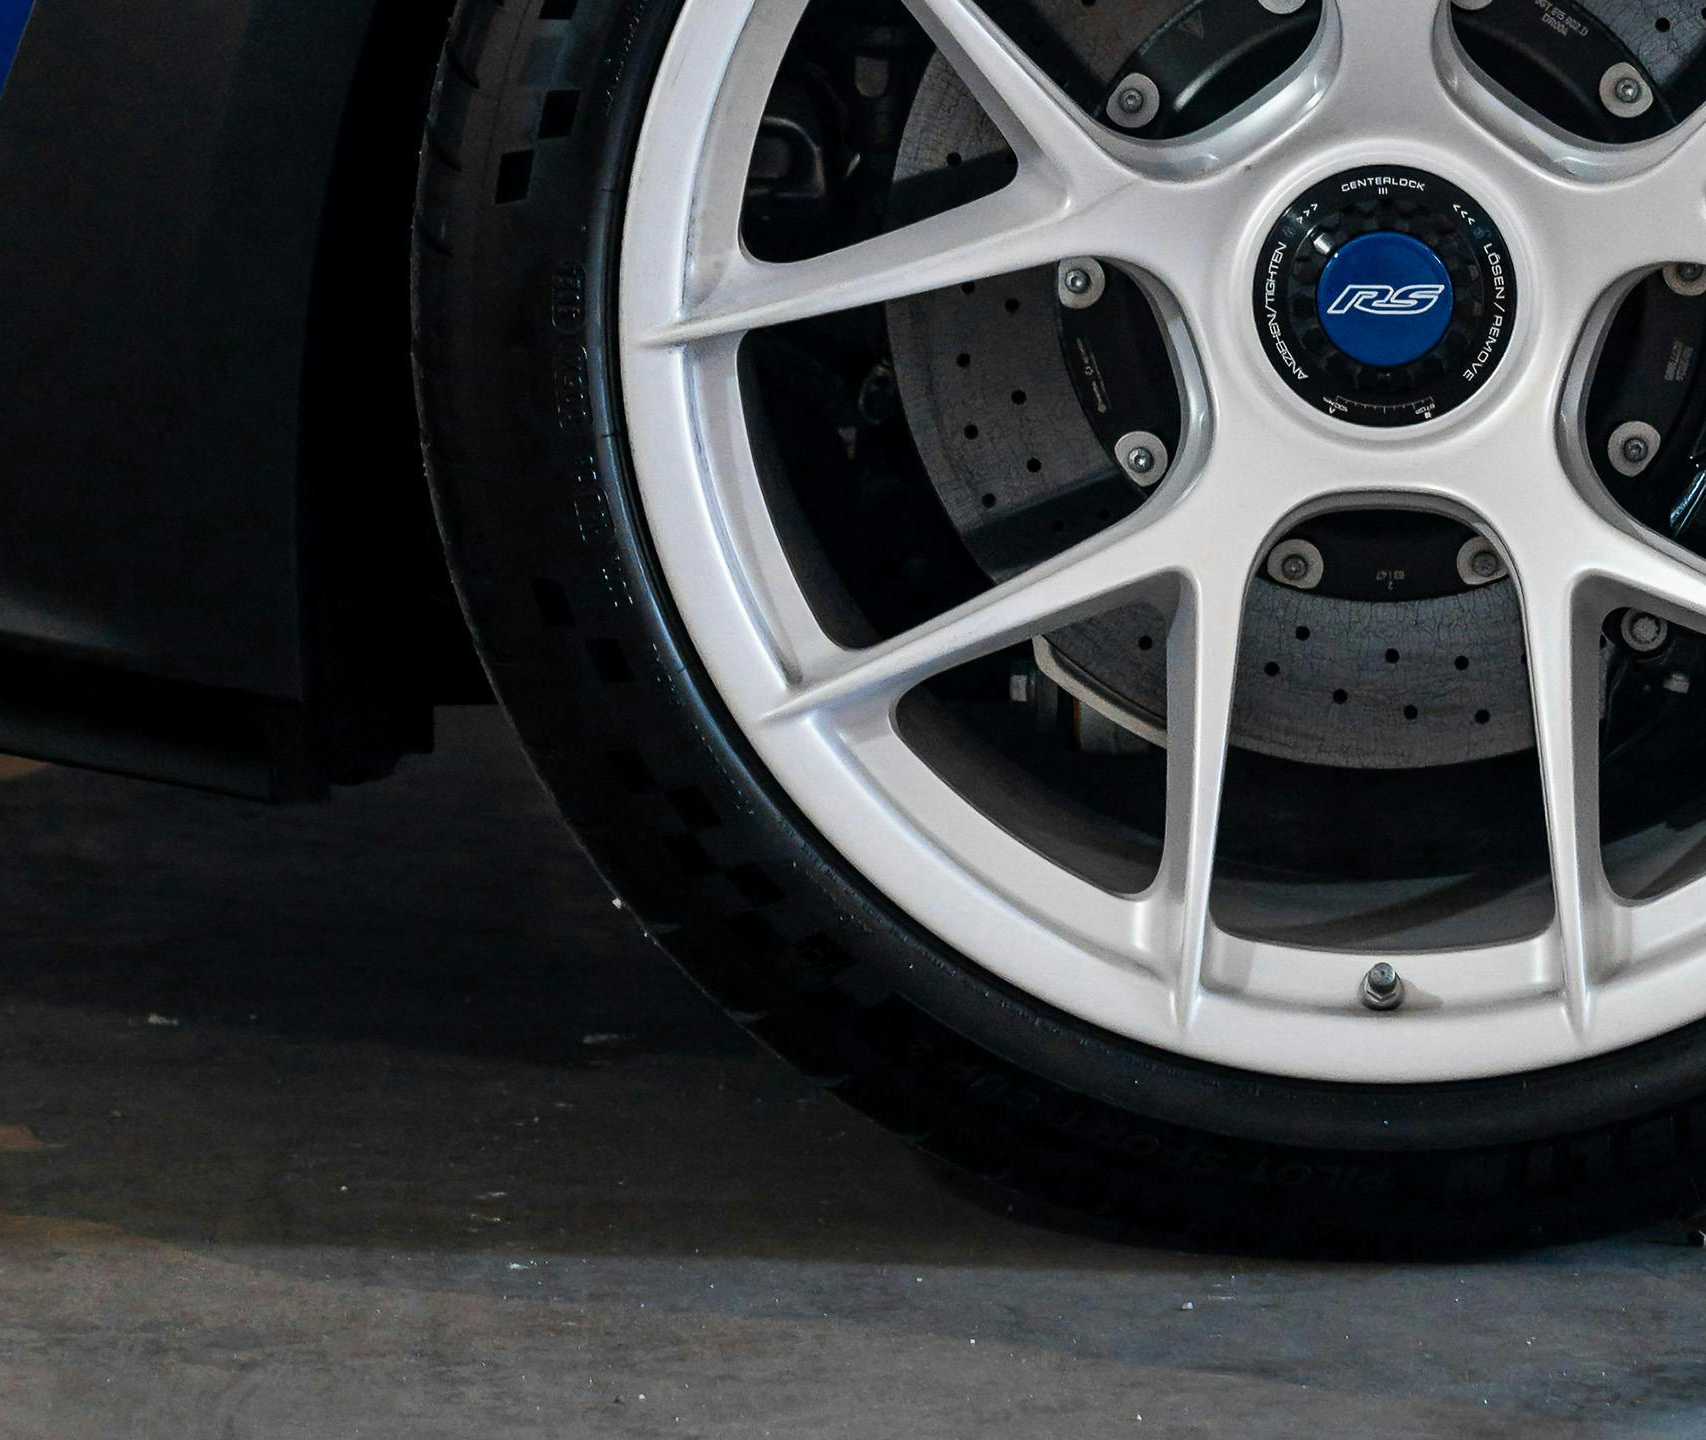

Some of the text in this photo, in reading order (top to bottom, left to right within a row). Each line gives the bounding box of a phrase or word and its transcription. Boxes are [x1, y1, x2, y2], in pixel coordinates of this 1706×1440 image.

[1341, 176, 1426, 192] CENTERLOCK
[1326, 284, 1446, 315] RS
[1463, 315, 1503, 382] REMOVE
